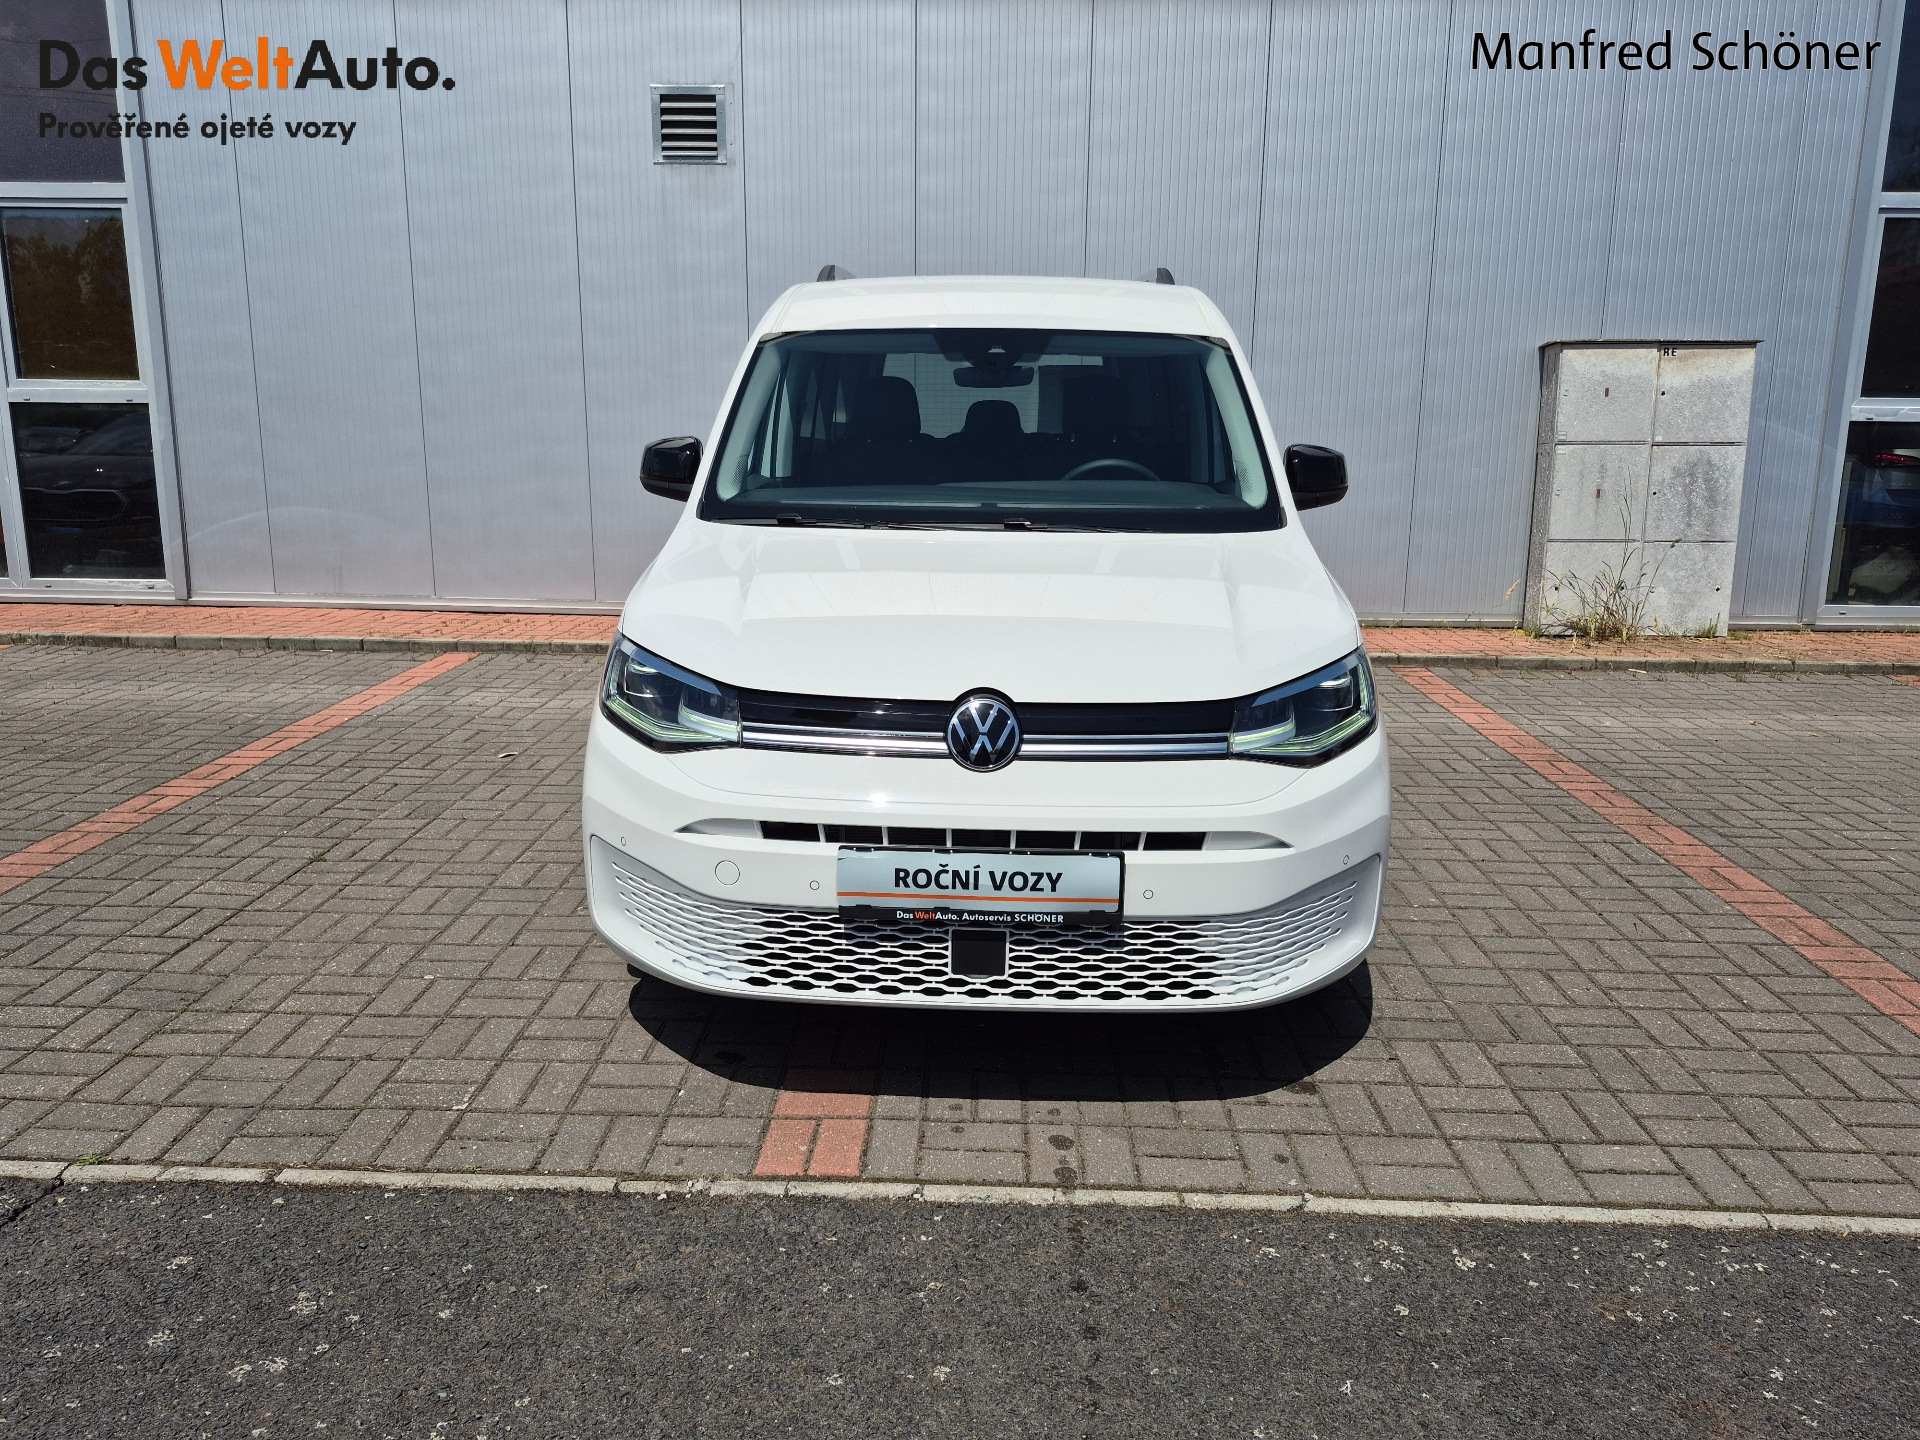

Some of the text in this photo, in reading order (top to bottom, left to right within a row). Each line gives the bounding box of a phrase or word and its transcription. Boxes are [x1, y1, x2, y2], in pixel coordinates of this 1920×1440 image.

[894, 863, 1063, 893] ROČNÍ VOZY
[896, 910, 914, 920] Das
[961, 912, 1012, 923] Autoservis
[1014, 912, 1064, 924] SCHÖNER
